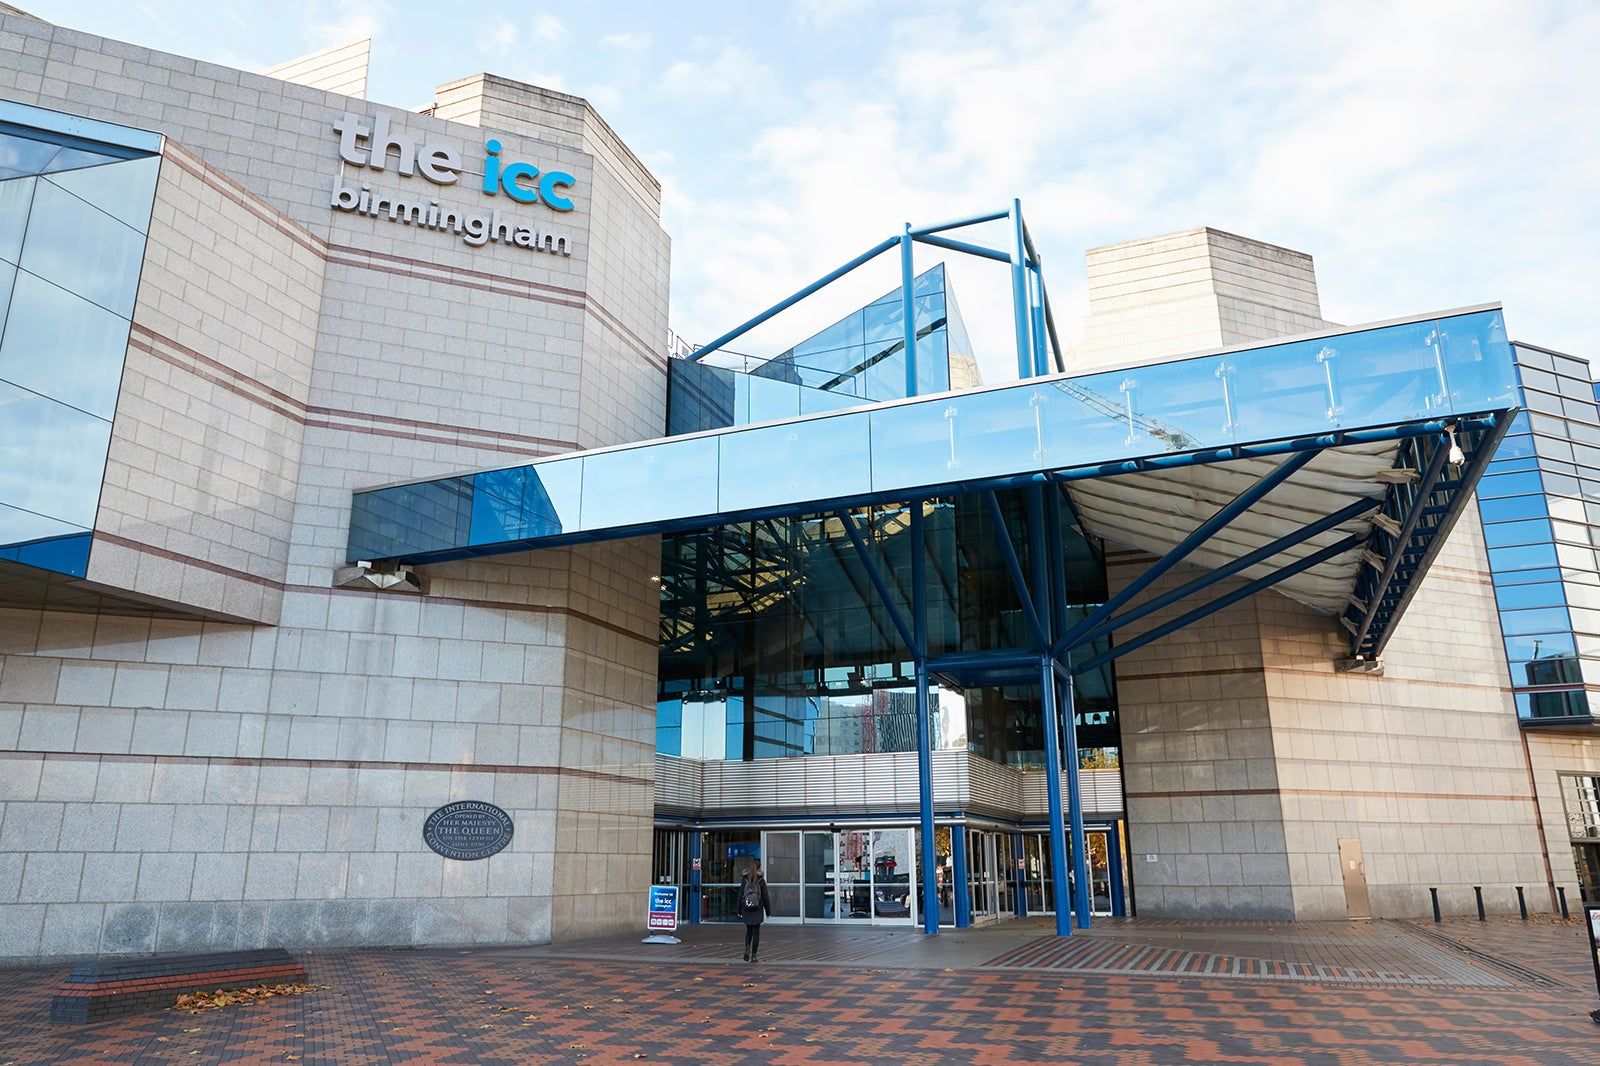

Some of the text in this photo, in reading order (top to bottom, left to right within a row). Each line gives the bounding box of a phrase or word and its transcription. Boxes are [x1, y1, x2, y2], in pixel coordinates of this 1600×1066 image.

[333, 111, 577, 212] the icc
[331, 175, 572, 257] birmingham
[429, 803, 510, 827] THE INTERNATIONAL
[462, 826, 500, 835] QUEEN
[426, 832, 511, 857] CONVENTION CENTRE
